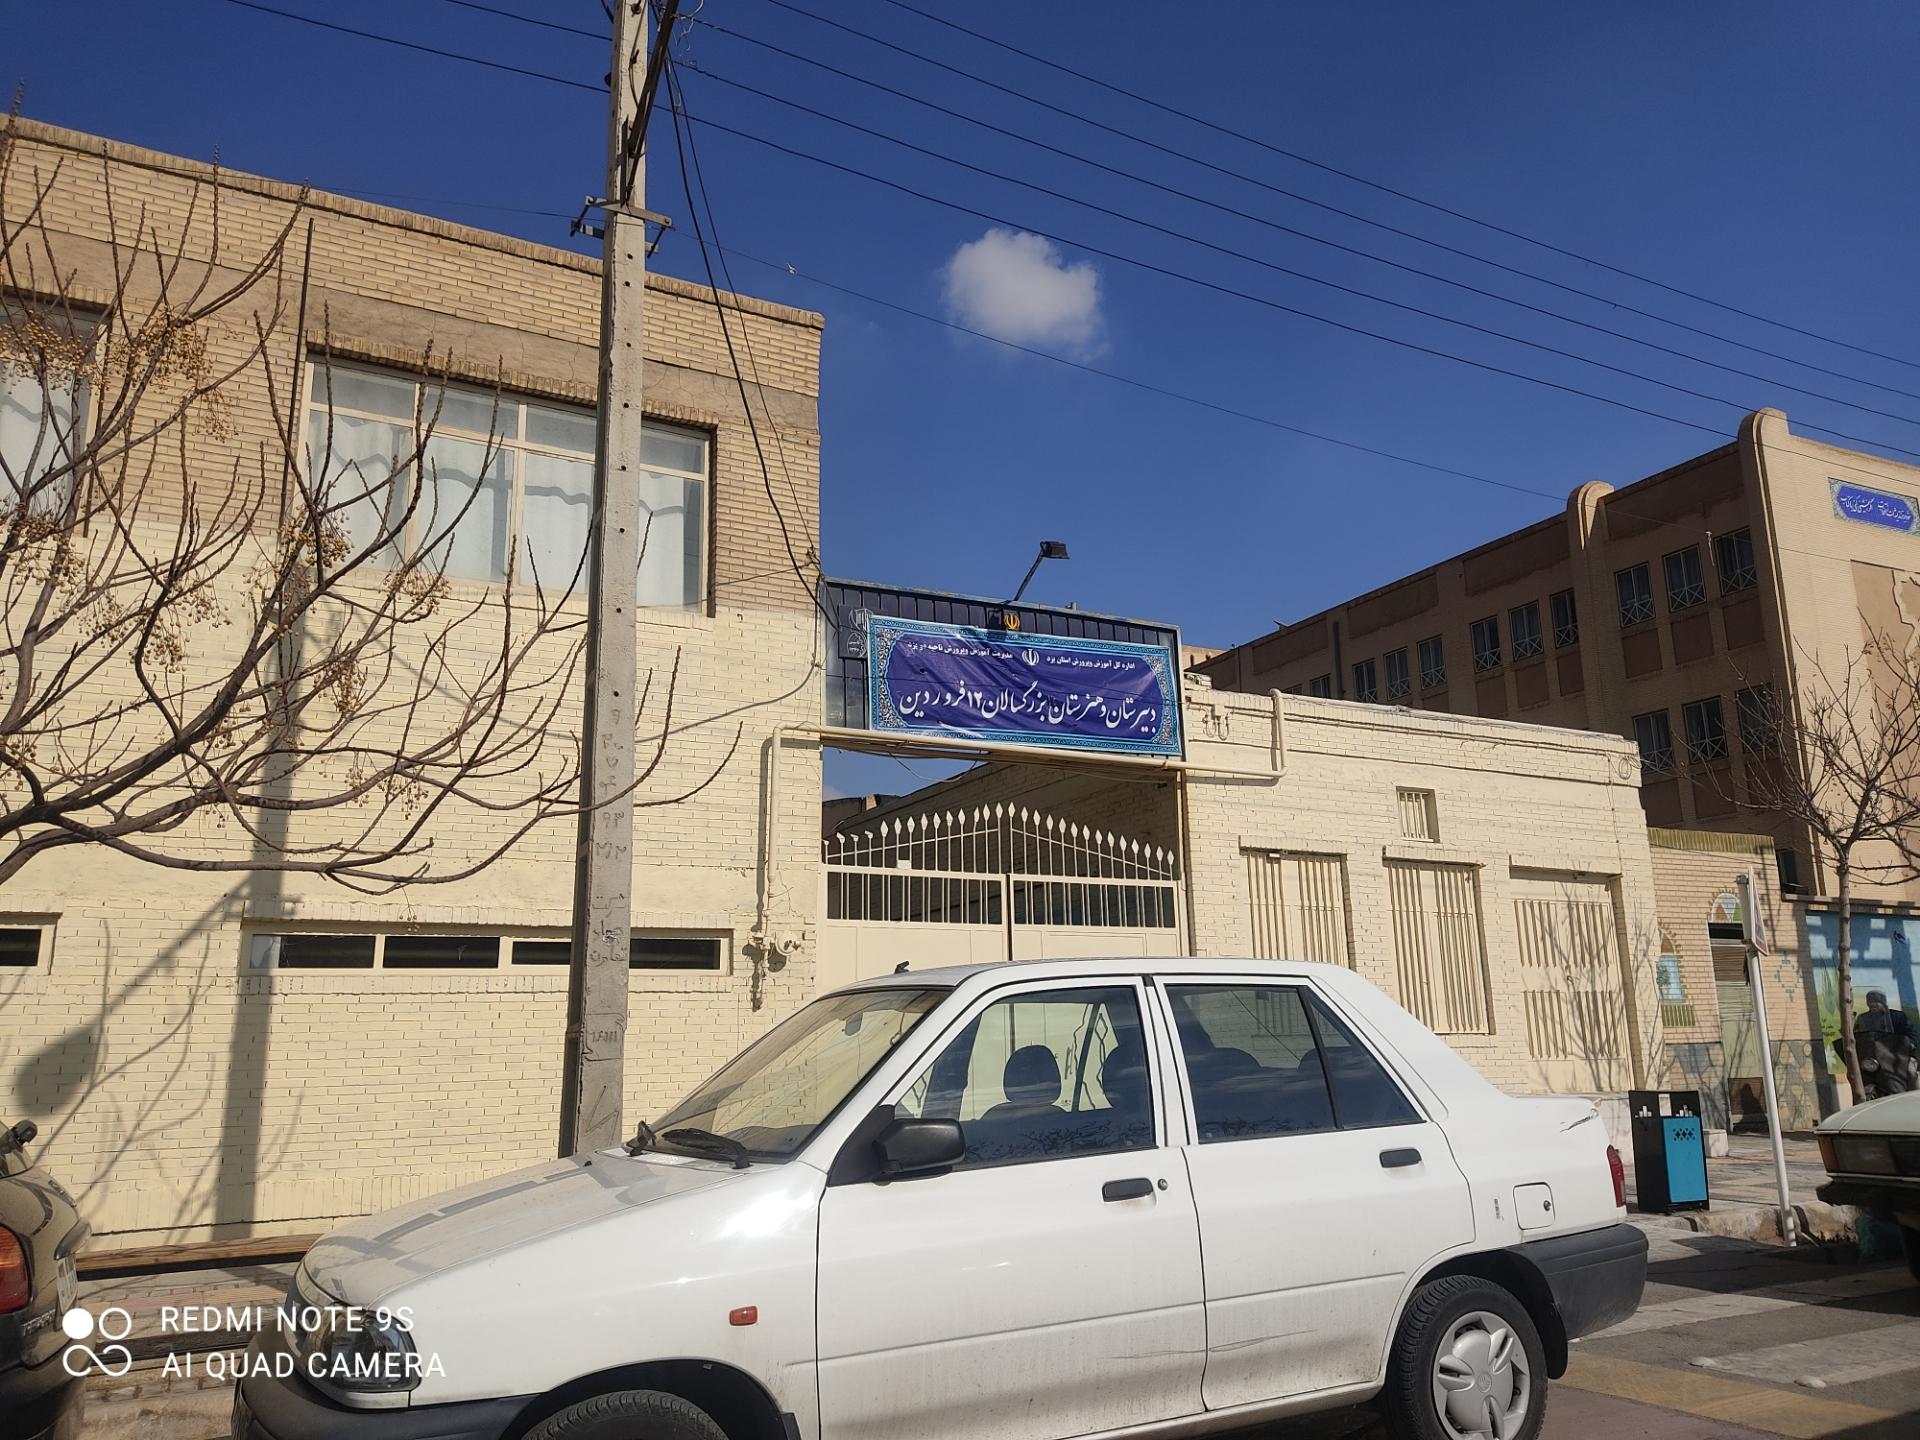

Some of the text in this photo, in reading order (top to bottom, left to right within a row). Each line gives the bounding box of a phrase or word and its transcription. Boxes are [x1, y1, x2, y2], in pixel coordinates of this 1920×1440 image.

[927, 643, 944, 653] ناحیه
[970, 647, 991, 657] آموزش
[992, 650, 1013, 660] مدیریت
[1056, 656, 1071, 665] استان
[1093, 659, 1112, 669] آموزش
[1113, 661, 1121, 669] کل
[1121, 662, 1136, 671] اداره
[899, 679, 966, 717] فروردین
[966, 690, 983, 709] ۱۲
[981, 680, 1048, 722] بزرگسالان
[1105, 697, 1156, 733] دبیرستان
